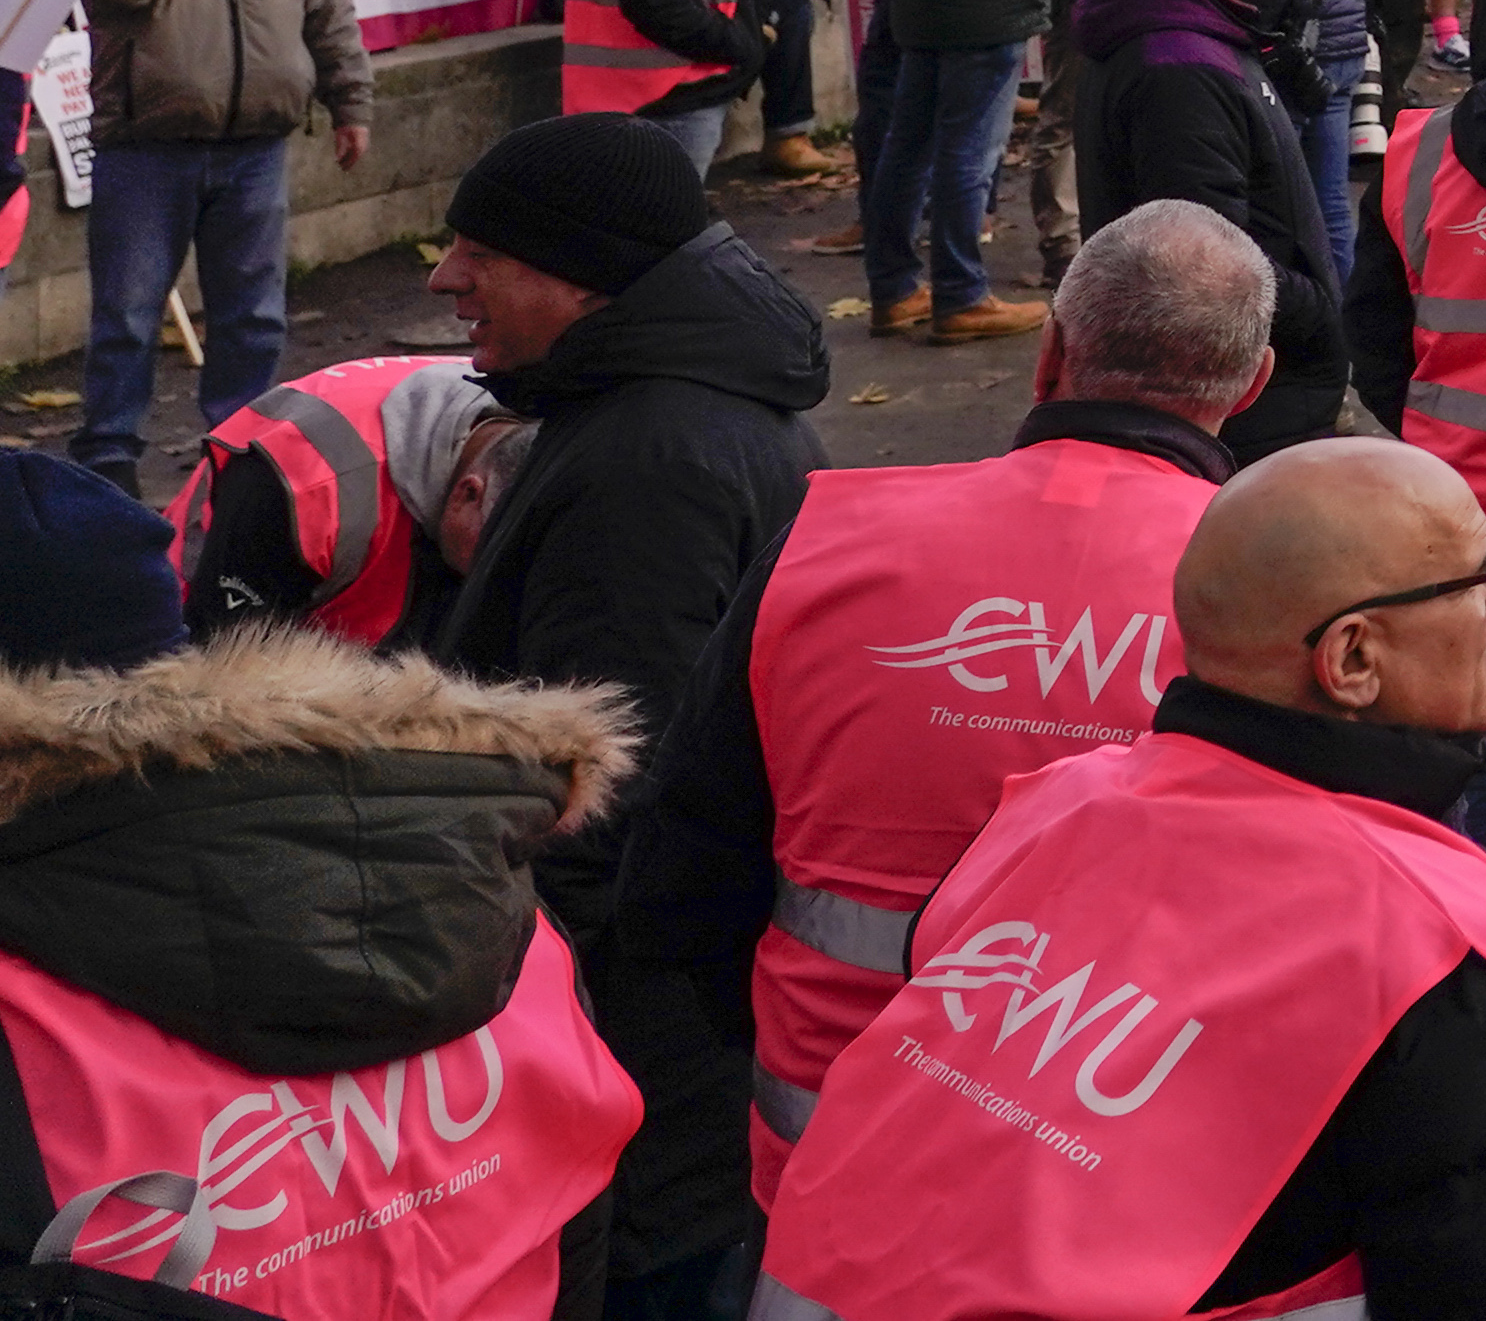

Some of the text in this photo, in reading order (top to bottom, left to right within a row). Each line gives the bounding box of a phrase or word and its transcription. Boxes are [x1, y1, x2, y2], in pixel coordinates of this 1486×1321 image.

[929, 707, 1134, 743] The communications
[909, 921, 1204, 1116] CWU
[73, 1025, 504, 1230] CWU
[1035, 1121, 1102, 1171] union
[199, 1154, 501, 1297] The communications union
